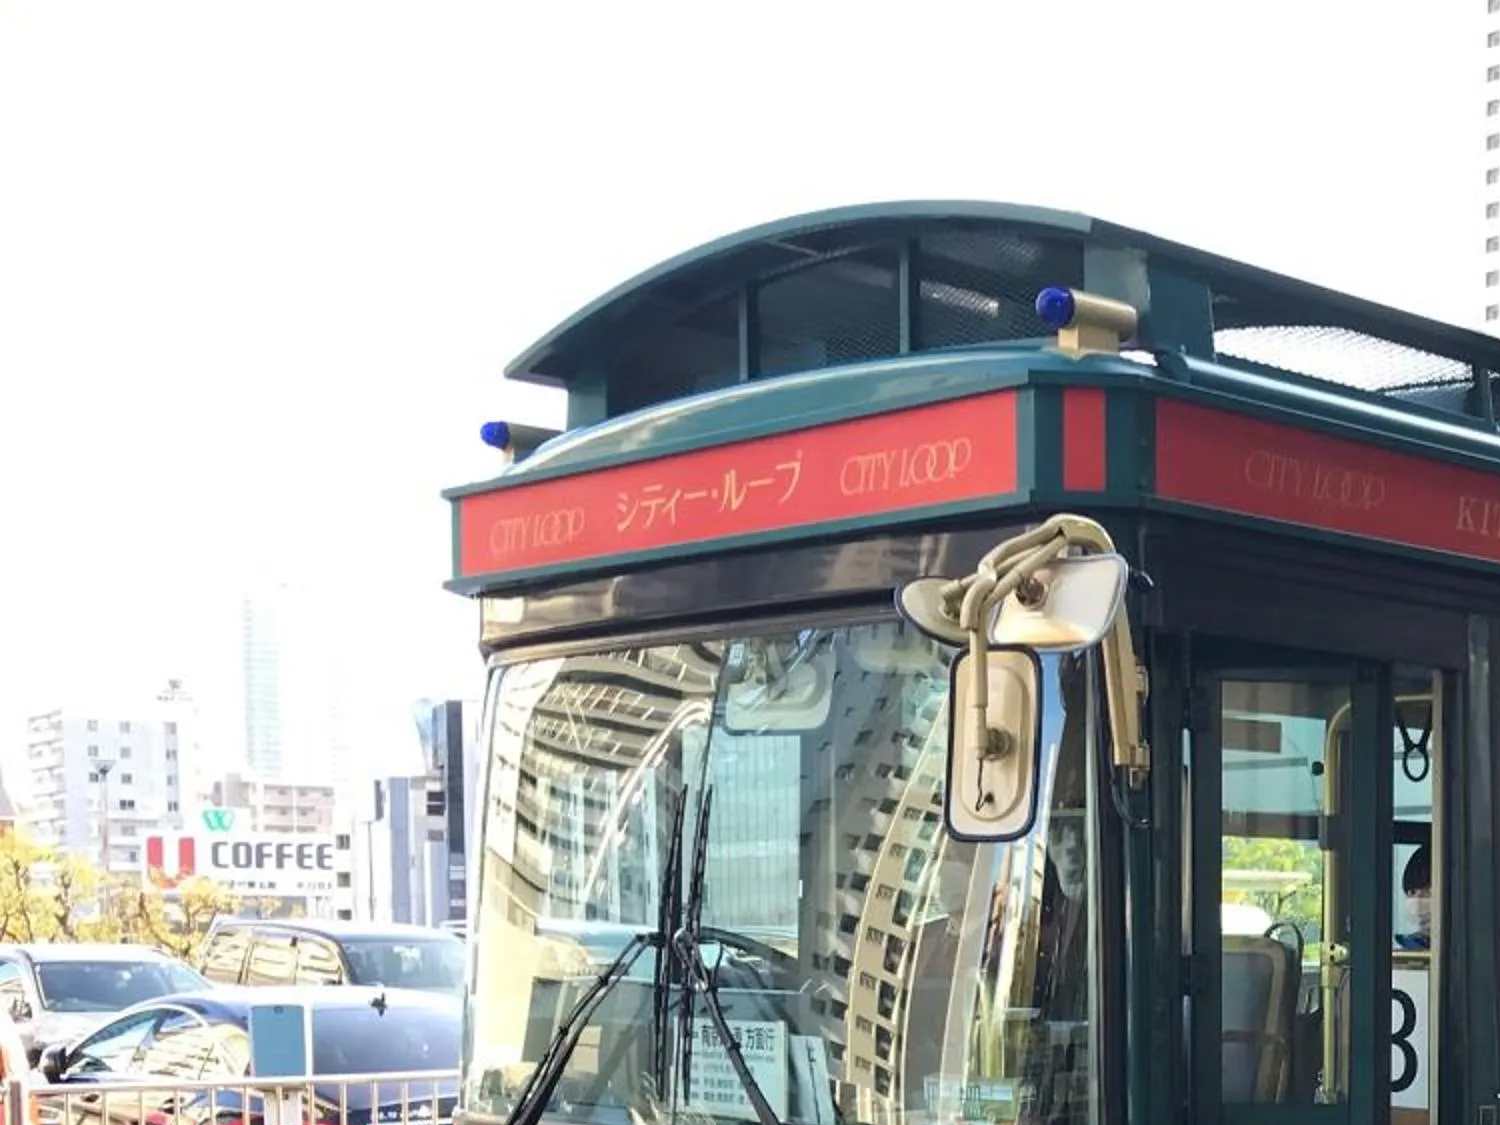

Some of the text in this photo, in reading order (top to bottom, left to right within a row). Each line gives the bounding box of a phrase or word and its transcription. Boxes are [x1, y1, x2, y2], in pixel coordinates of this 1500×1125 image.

[616, 450, 804, 533] シティー・ループ
[839, 437, 972, 496] CITY LOOP
[211, 841, 333, 870] COFFEE
